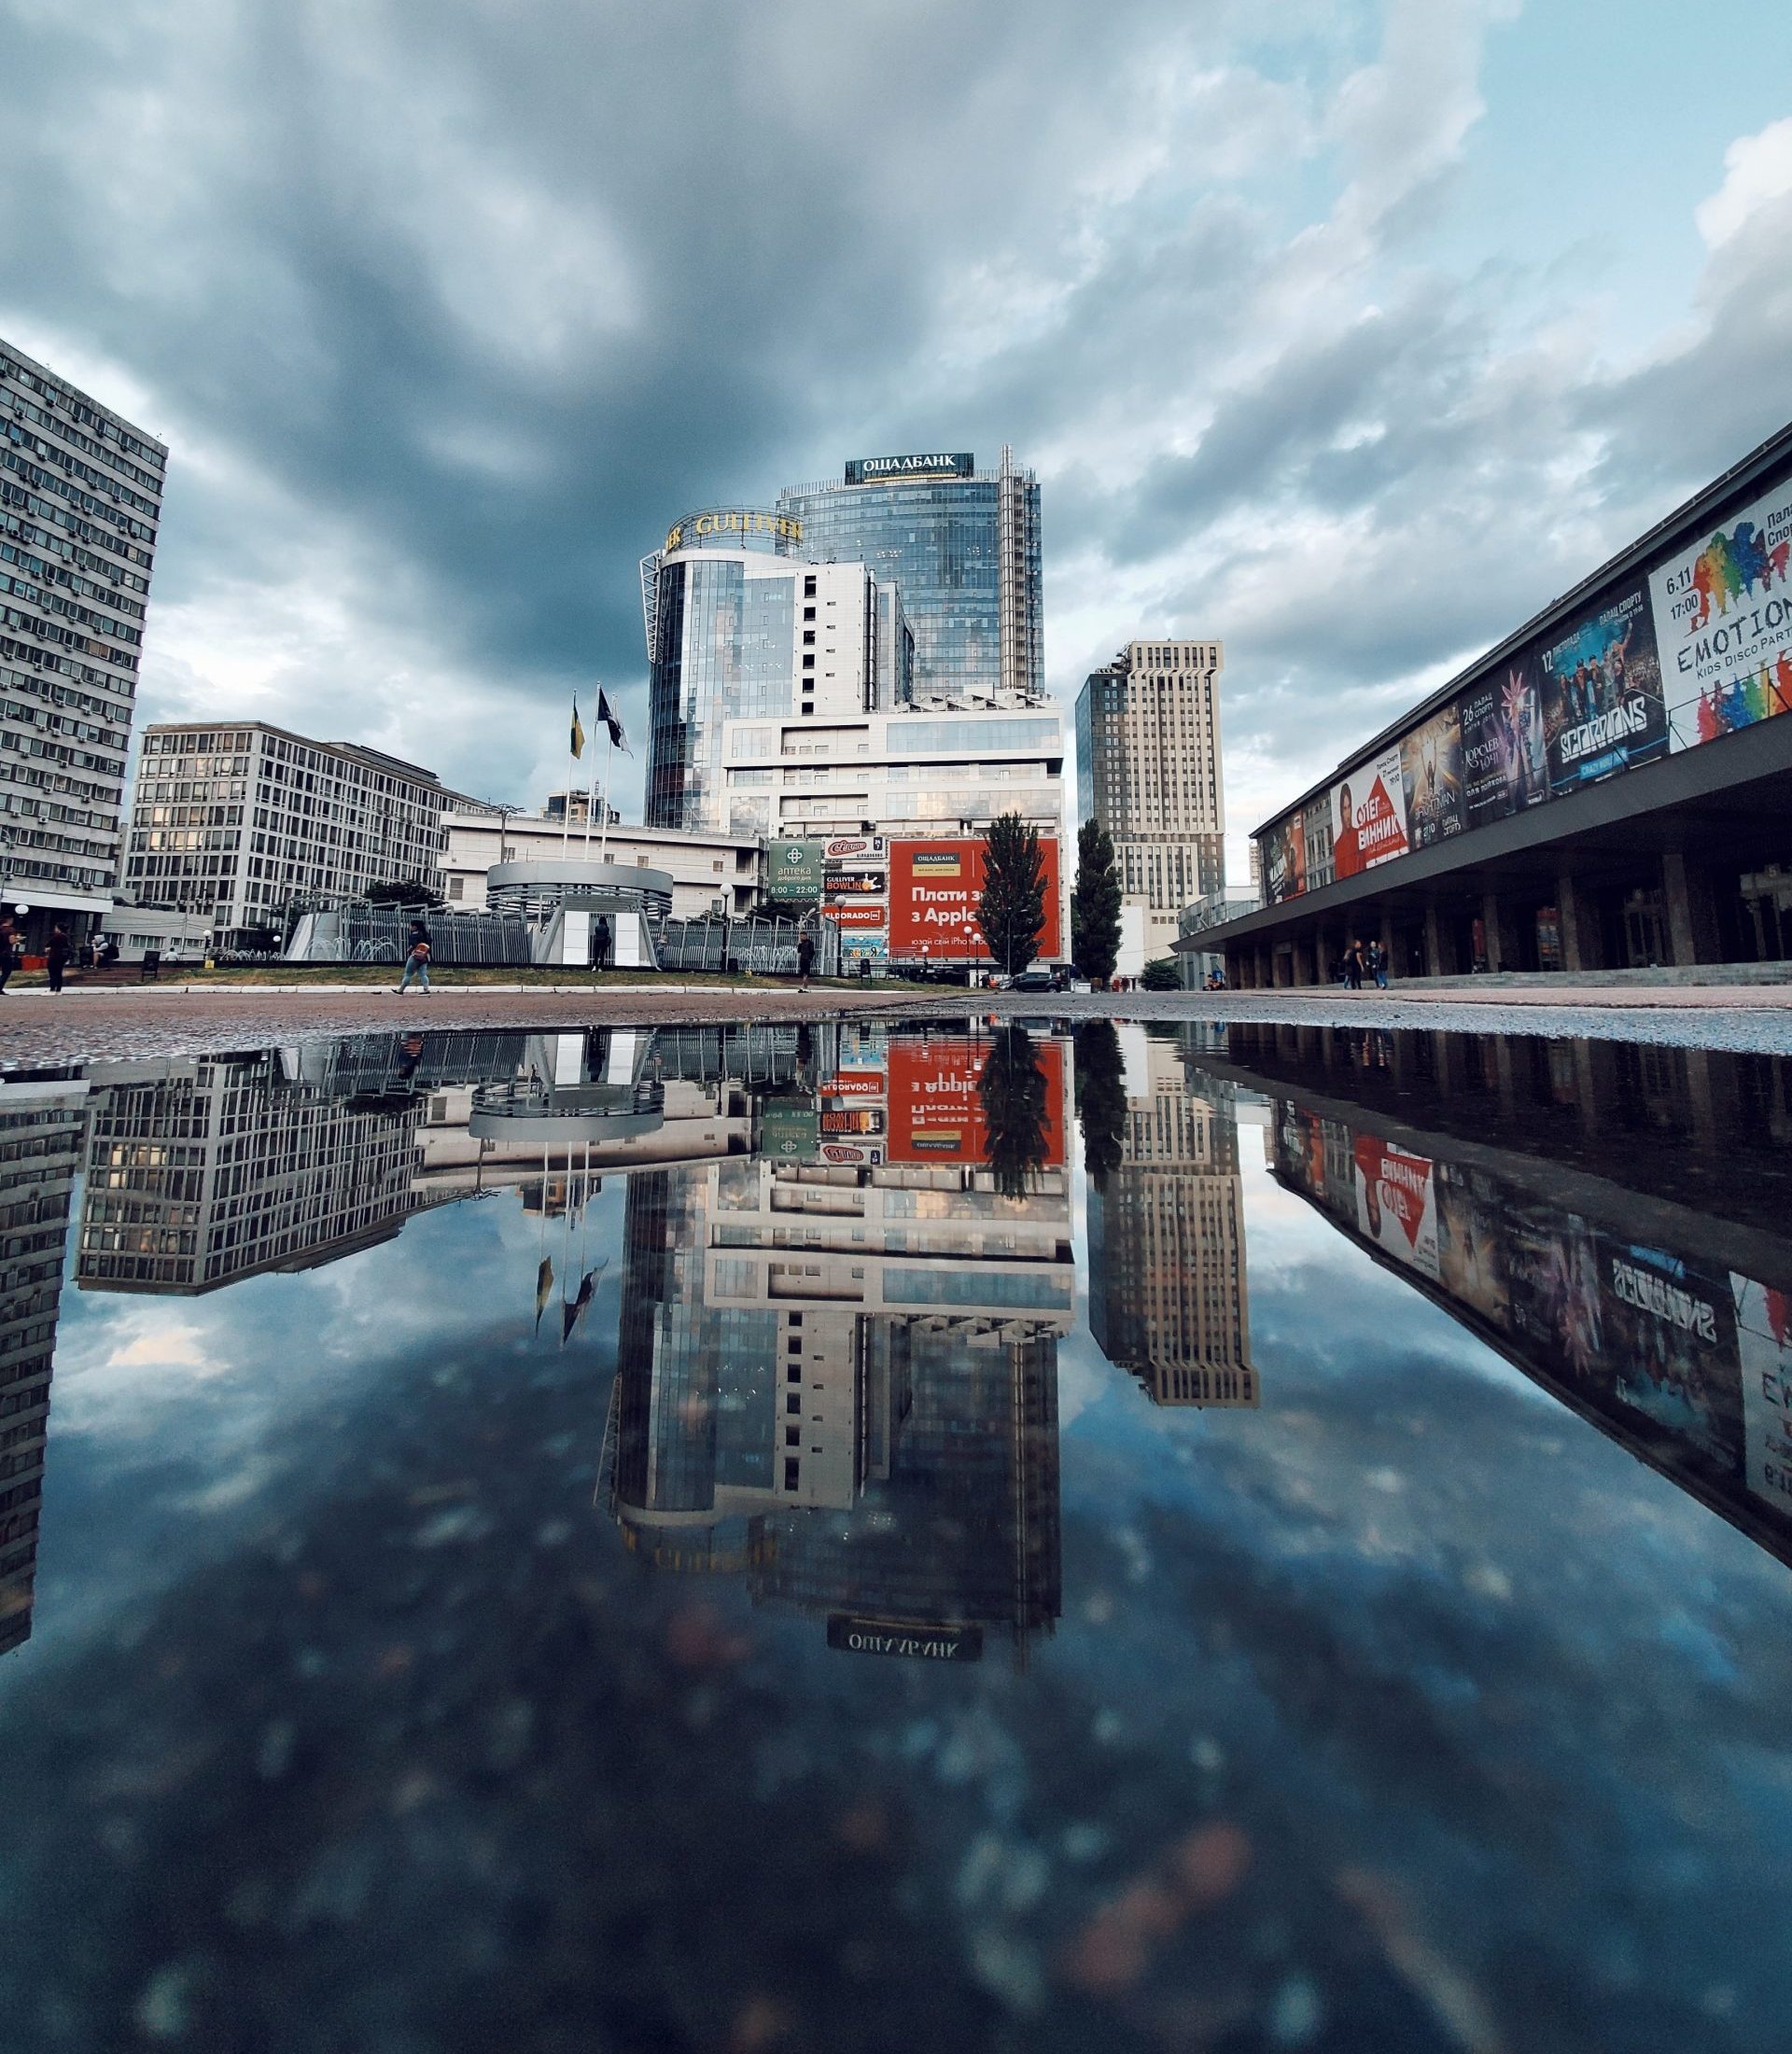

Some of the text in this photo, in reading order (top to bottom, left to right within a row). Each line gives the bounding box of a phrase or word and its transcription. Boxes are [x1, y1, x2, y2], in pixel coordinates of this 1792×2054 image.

[863, 454, 957, 472] ОЩАДБАНК
[695, 512, 804, 538] GULLIVER
[1666, 566, 1691, 595] 6.11
[1618, 590, 1642, 613] СПОРТУ
[1671, 594, 1699, 621] 17:00
[1542, 650, 1554, 673] 12
[1697, 662, 1721, 679] KIDS
[1725, 645, 1758, 666] DISCO
[1463, 705, 1474, 726] 26
[1560, 696, 1647, 763] SCORPIONS
[1356, 796, 1380, 826] ОЛЕГ
[1358, 814, 1399, 851] ВИННИК
[777, 867, 811, 875] аптека
[771, 886, 788, 894] 8:00
[796, 886, 818, 894] 22:00
[827, 881, 863, 890] BOWLIN
[912, 887, 967, 901] Плати
[911, 912, 920, 922] з
